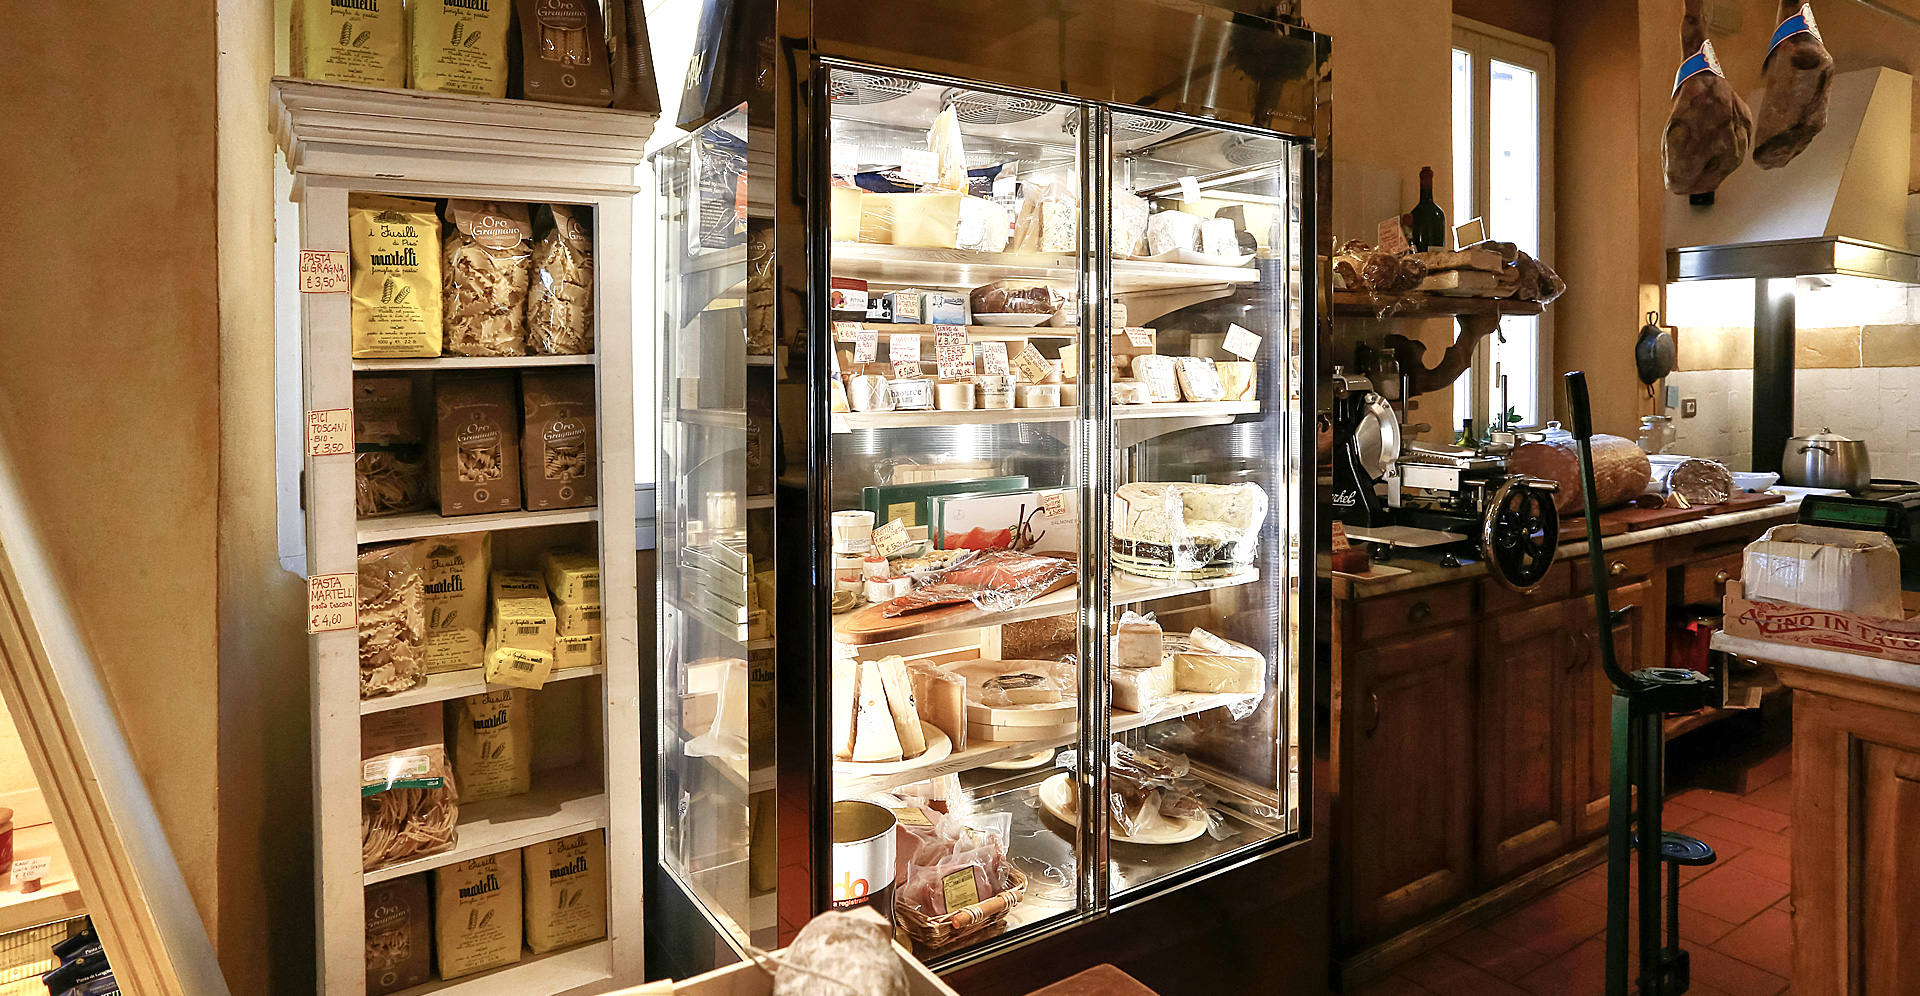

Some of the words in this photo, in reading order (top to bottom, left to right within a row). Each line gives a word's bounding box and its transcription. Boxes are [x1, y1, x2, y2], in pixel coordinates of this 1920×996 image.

[482, 216, 508, 228] Oro
[380, 225, 418, 238] Fusilli
[473, 226, 520, 238] Gragnano
[304, 253, 331, 264] PASTA
[370, 248, 420, 266] martelli
[315, 277, 334, 290] 3,50
[891, 390, 922, 398] haource
[311, 412, 328, 423] PICI
[467, 424, 490, 434] Oro
[552, 421, 574, 432] Oro
[322, 443, 344, 454] 3,50
[312, 578, 342, 589] PASTA
[311, 588, 354, 601] MARTELLI
[312, 602, 328, 611] pasta
[312, 615, 320, 627] €
[322, 614, 342, 627] 4,60
[1824, 616, 1850, 632] IN
[473, 710, 508, 730] martelli
[549, 856, 588, 880] martelli
[458, 874, 501, 898] martelli
[374, 906, 398, 919] Oro
